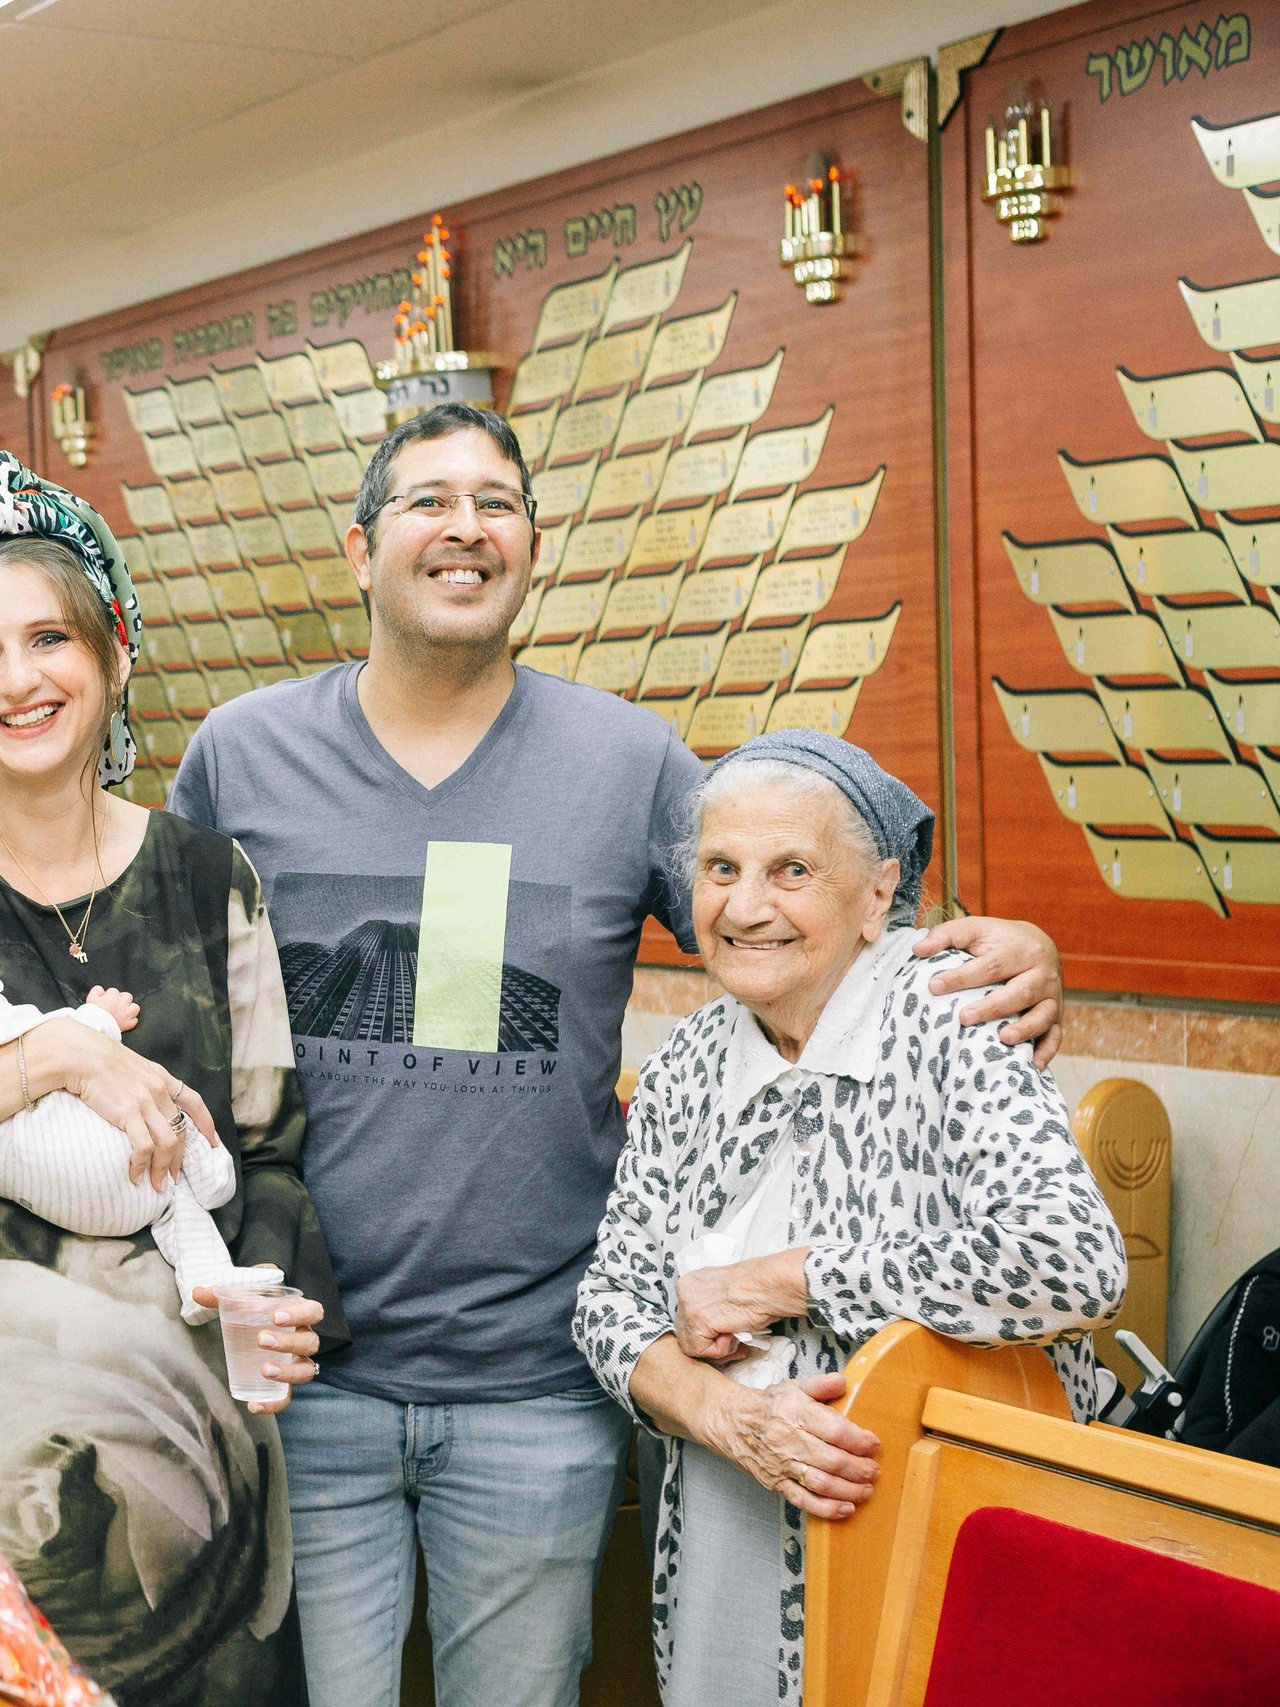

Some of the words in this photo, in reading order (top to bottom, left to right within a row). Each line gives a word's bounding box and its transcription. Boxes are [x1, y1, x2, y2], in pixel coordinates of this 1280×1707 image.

[1085, 12, 1251, 104] מאושר
[564, 203, 637, 258] חיים
[654, 180, 704, 243] עץ
[493, 227, 548, 279] היא
[294, 1042, 379, 1066] OINT
[402, 1053, 444, 1072] OF
[467, 1058, 558, 1076] VIEW
[320, 1071, 358, 1083] ABOUT
[364, 1075, 386, 1086] THE
[392, 1078, 418, 1089] WAY
[423, 1081, 447, 1092] YOU
[453, 1085, 485, 1094] LOOK
[491, 1085, 505, 1094] AT
[511, 1085, 552, 1094] THINGS
